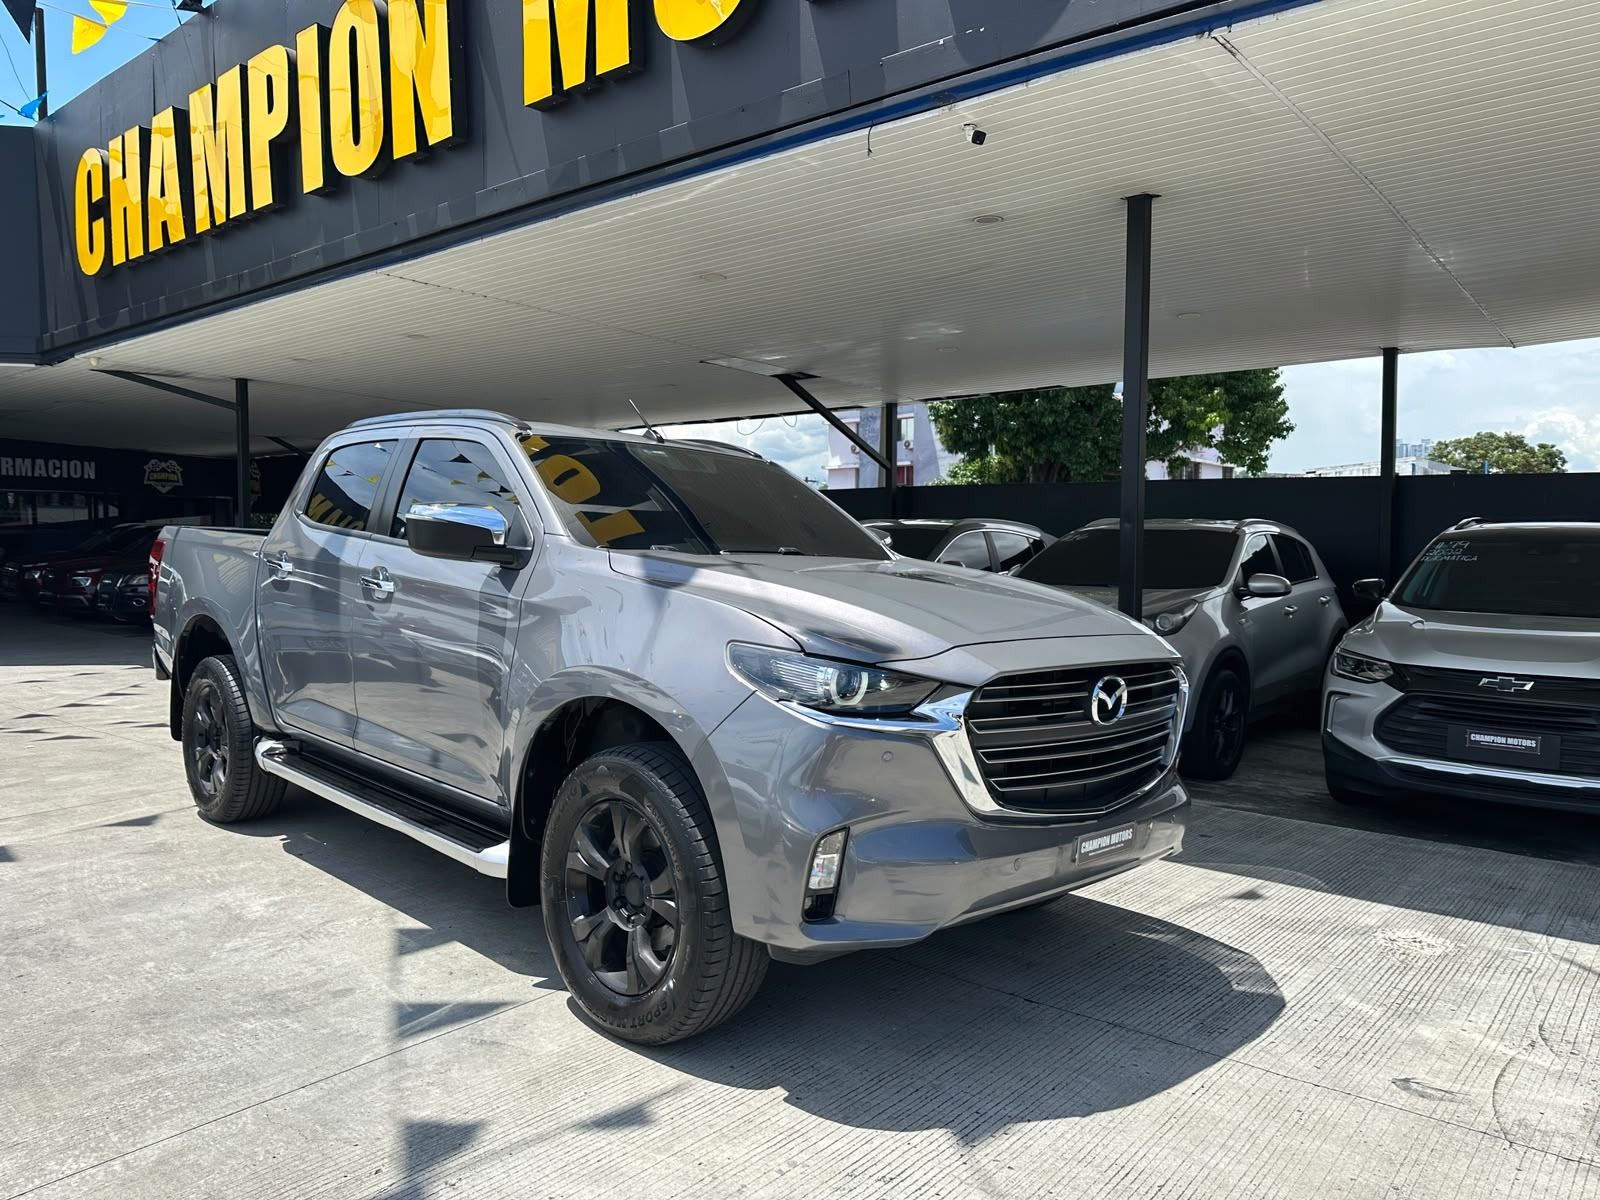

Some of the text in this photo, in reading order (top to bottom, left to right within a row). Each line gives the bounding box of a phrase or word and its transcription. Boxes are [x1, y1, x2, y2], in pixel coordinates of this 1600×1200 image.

[75, 0, 454, 277] CHAMPION
[0, 456, 96, 480] RMACION
[1470, 733, 1506, 744] CHAMPION
[1507, 737, 1536, 747] MOTORS
[1081, 835, 1110, 853] CHAMPION
